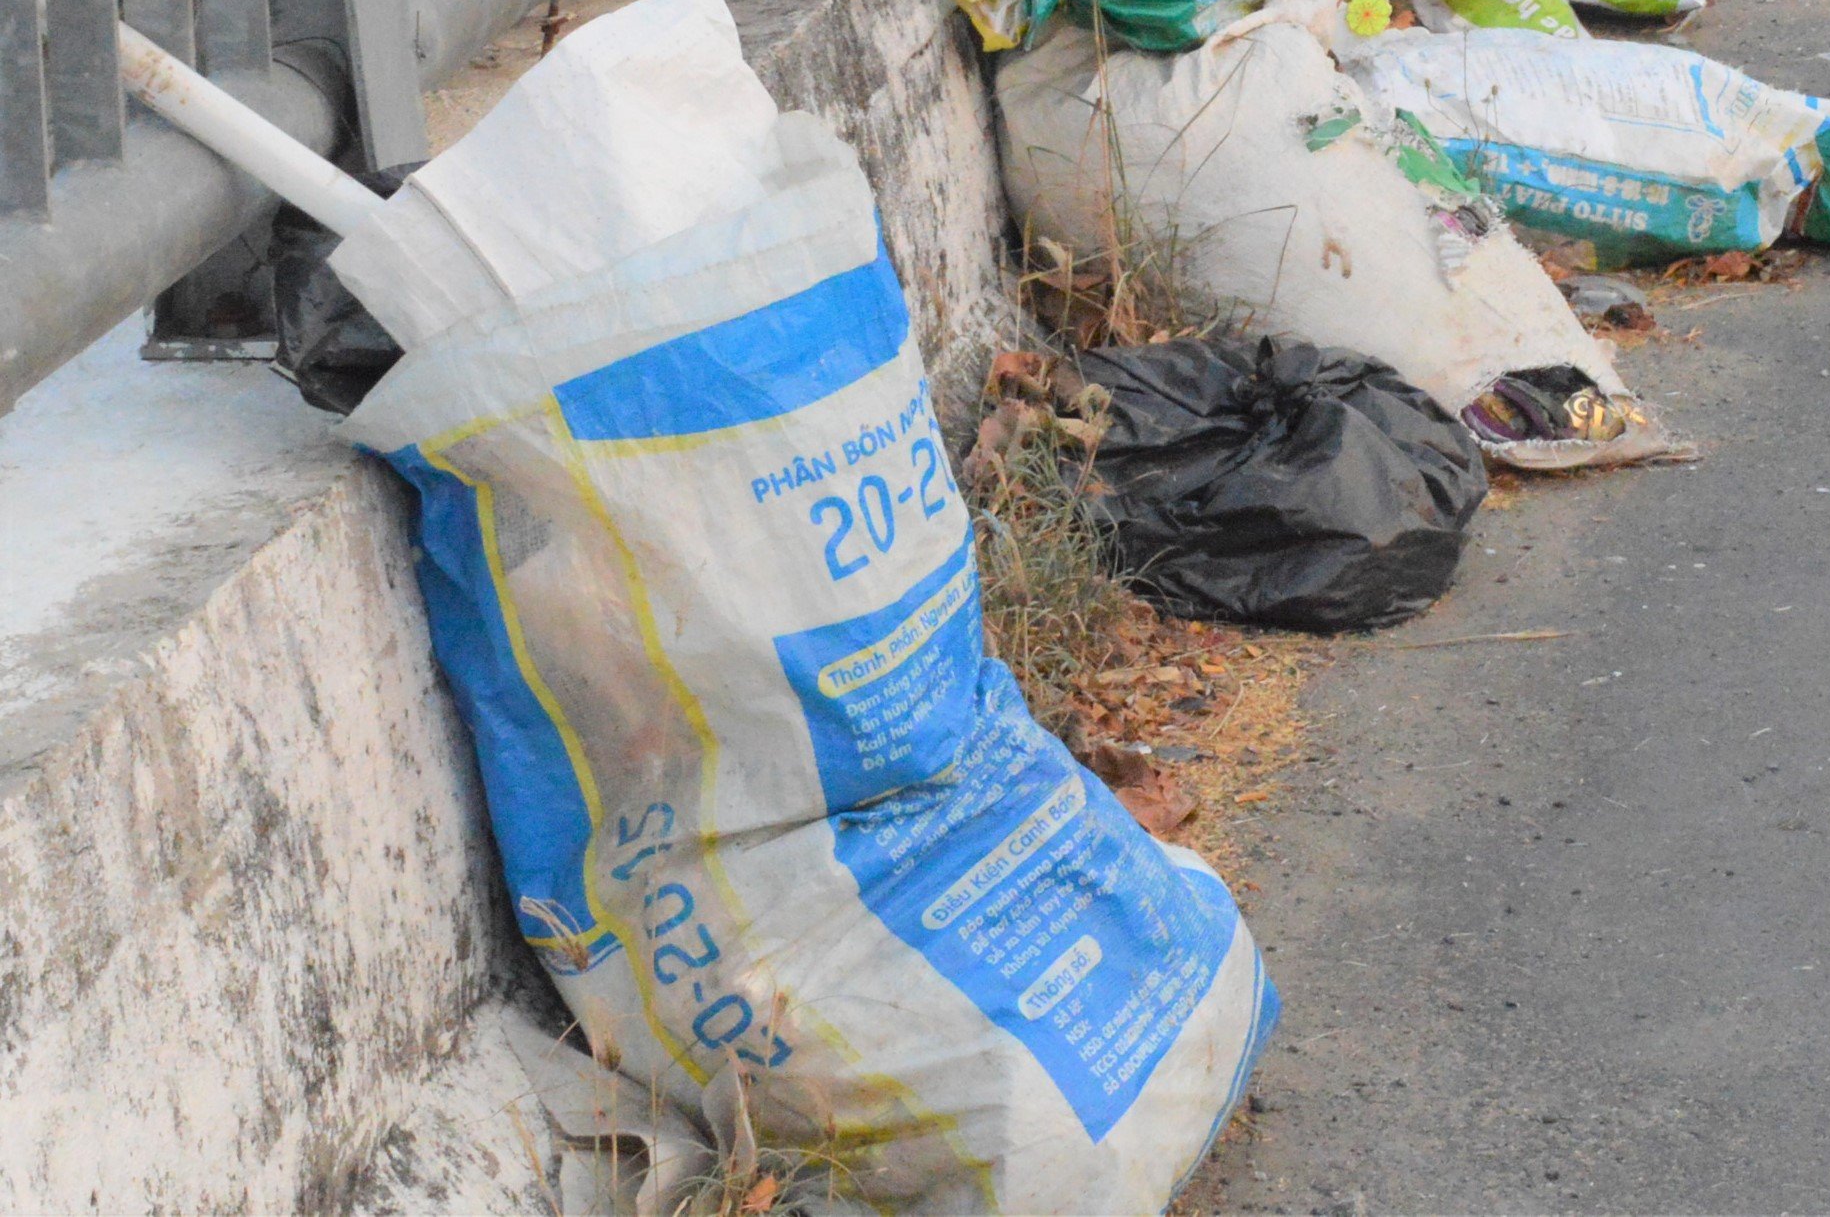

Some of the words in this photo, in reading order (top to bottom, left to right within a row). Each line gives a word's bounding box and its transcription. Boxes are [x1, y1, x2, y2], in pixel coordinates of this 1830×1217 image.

[1572, 198, 1649, 232] SITTO
[751, 451, 837, 503] PHÂN
[810, 418, 956, 581] 20-2
[827, 651, 888, 689] Thành
[931, 888, 972, 922] Điều
[1026, 966, 1076, 1011] Thông
